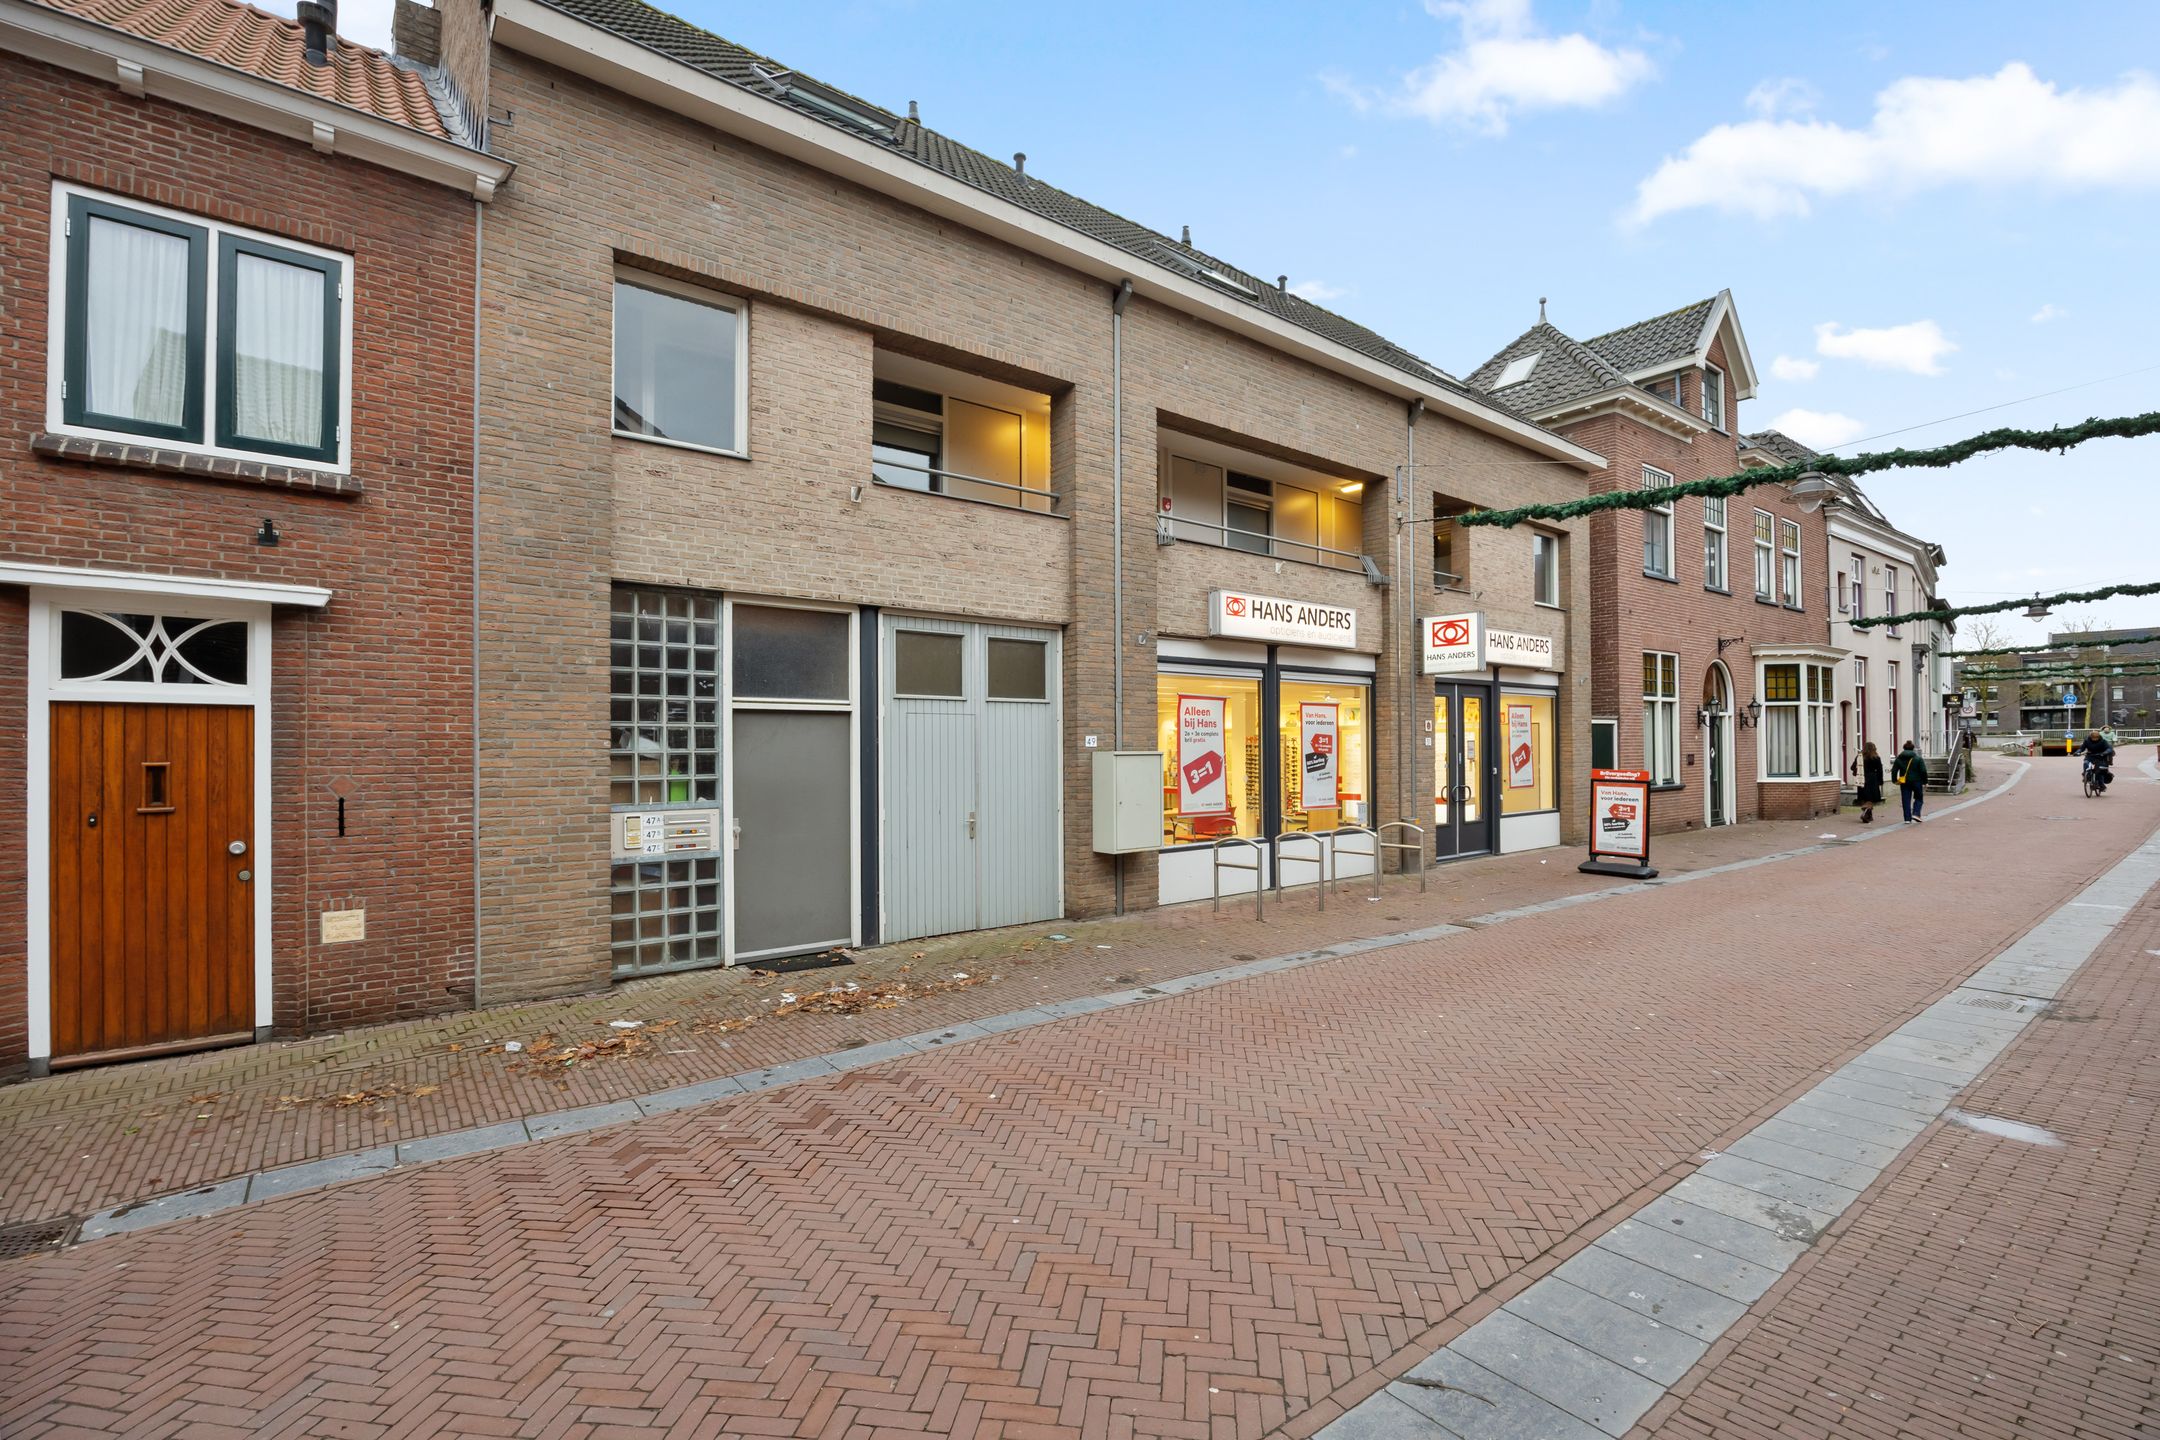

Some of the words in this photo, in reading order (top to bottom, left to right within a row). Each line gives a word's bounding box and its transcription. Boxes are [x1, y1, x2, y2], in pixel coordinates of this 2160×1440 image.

[1251, 599, 1293, 624] HANS
[1297, 606, 1351, 630] ANDERS
[1489, 632, 1514, 650] HANS
[1516, 636, 1550, 654] ANDERS
[1426, 652, 1446, 661] HANS
[1447, 650, 1476, 660] ANDERS
[1184, 706, 1211, 717] Alleen
[1184, 718, 1196, 730] bij
[1197, 718, 1218, 728] Hans
[1087, 737, 1096, 745] 49
[1190, 760, 1214, 784] 3=1
